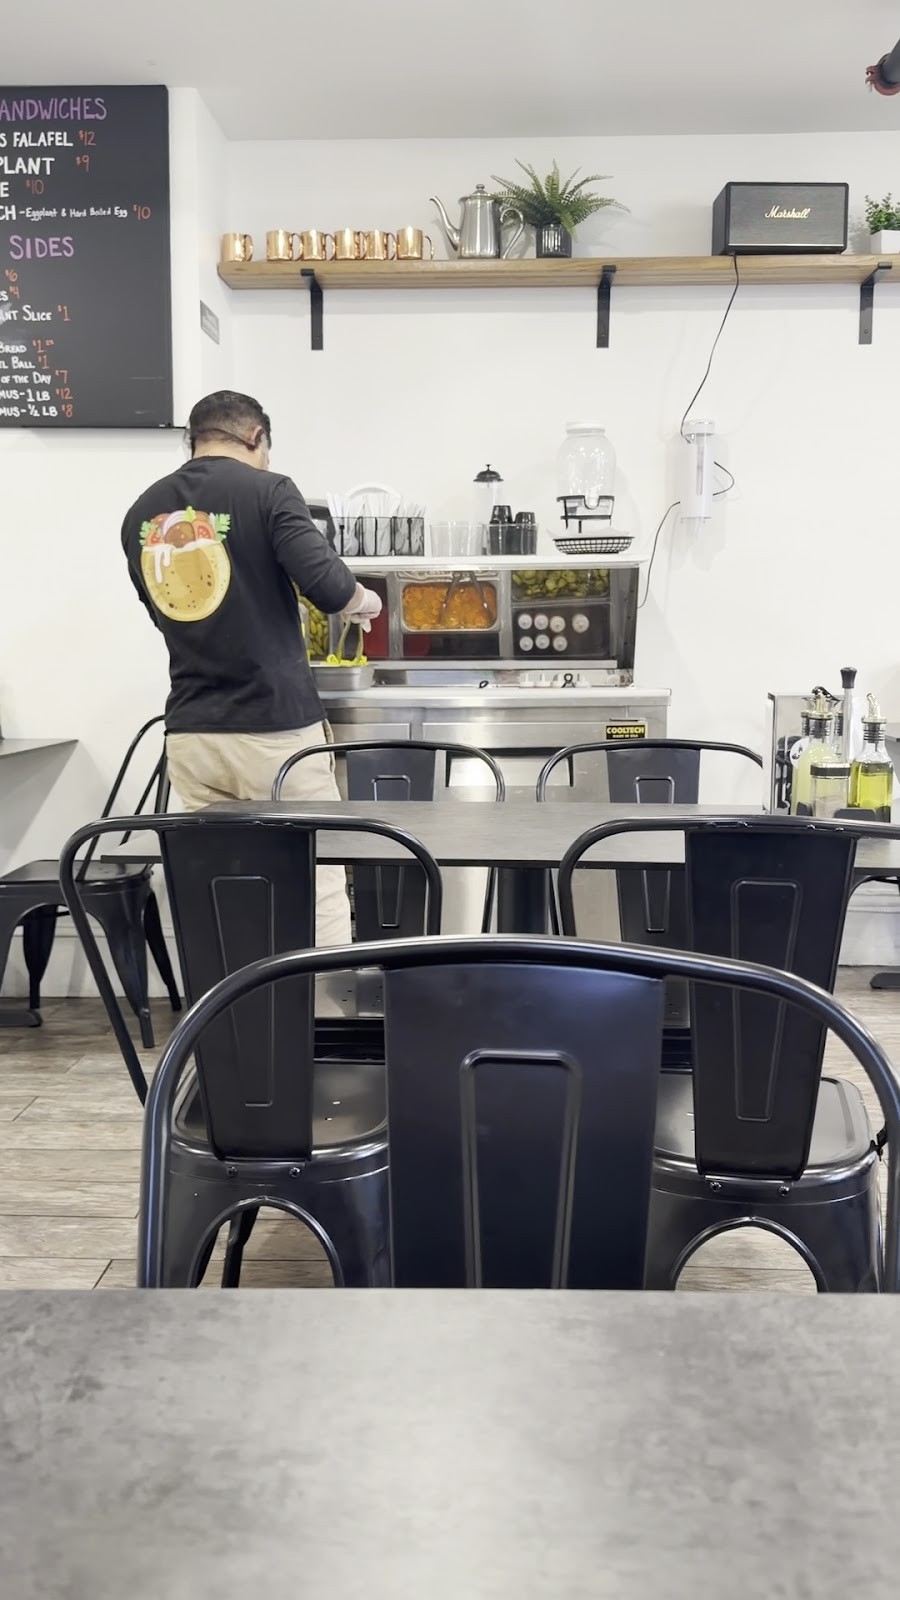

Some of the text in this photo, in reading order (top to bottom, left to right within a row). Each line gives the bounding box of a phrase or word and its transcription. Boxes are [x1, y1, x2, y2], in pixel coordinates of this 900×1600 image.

[13, 131, 73, 147] FALAFEL
[78, 129, 96, 146] $12
[75, 155, 90, 172] $9
[26, 179, 45, 194] $10
[69, 208, 87, 218] Hard
[89, 206, 112, 216] Boiled
[114, 206, 128, 218] Egg
[132, 204, 151, 220] $10
[764, 205, 811, 219] Marshall
[9, 235, 75, 260] SIDES
[57, 304, 71, 321] $1
[38, 355, 50, 369] $1
[55, 369, 68, 384] $7
[36, 390, 51, 402] LB
[55, 387, 73, 400] $12
[42, 405, 58, 417] LB
[61, 404, 74, 418] $8
